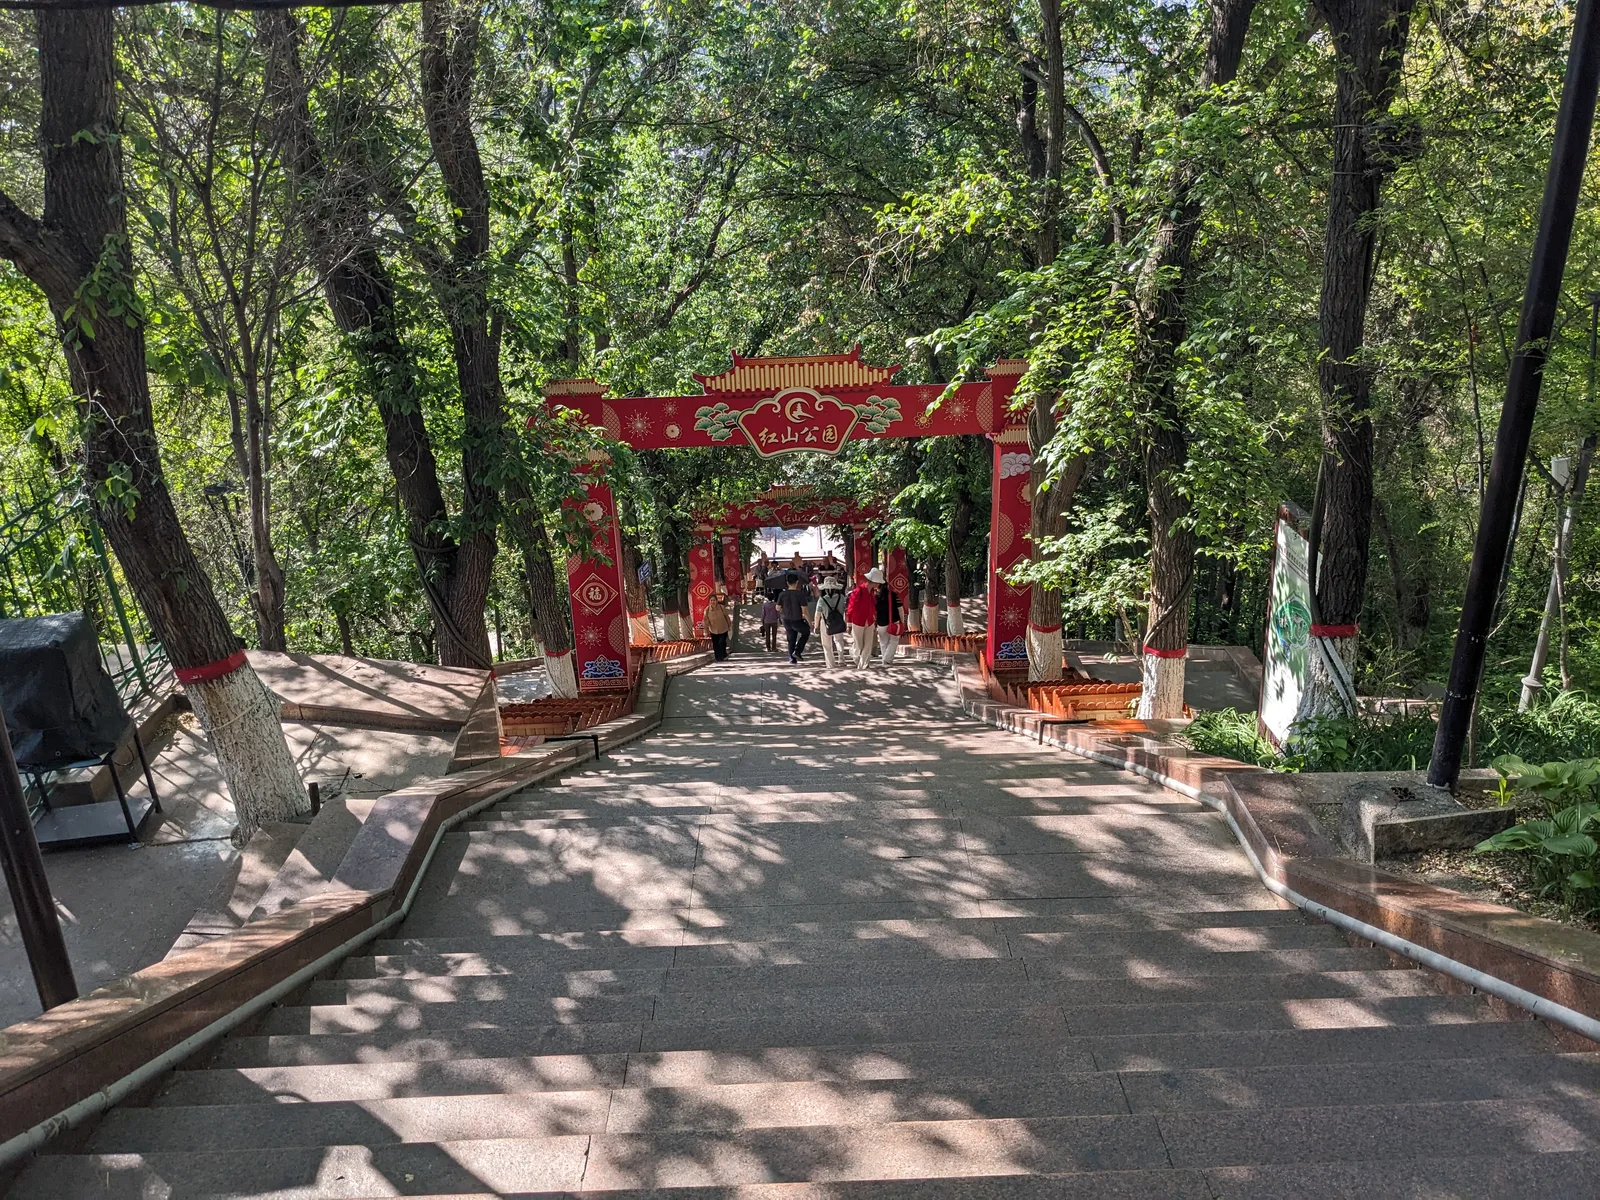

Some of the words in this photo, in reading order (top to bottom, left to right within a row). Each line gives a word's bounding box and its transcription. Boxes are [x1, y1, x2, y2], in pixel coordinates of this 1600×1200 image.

[758, 424, 838, 447] 红山公园
[782, 513, 819, 524] 红山公
[588, 586, 602, 601] 福
